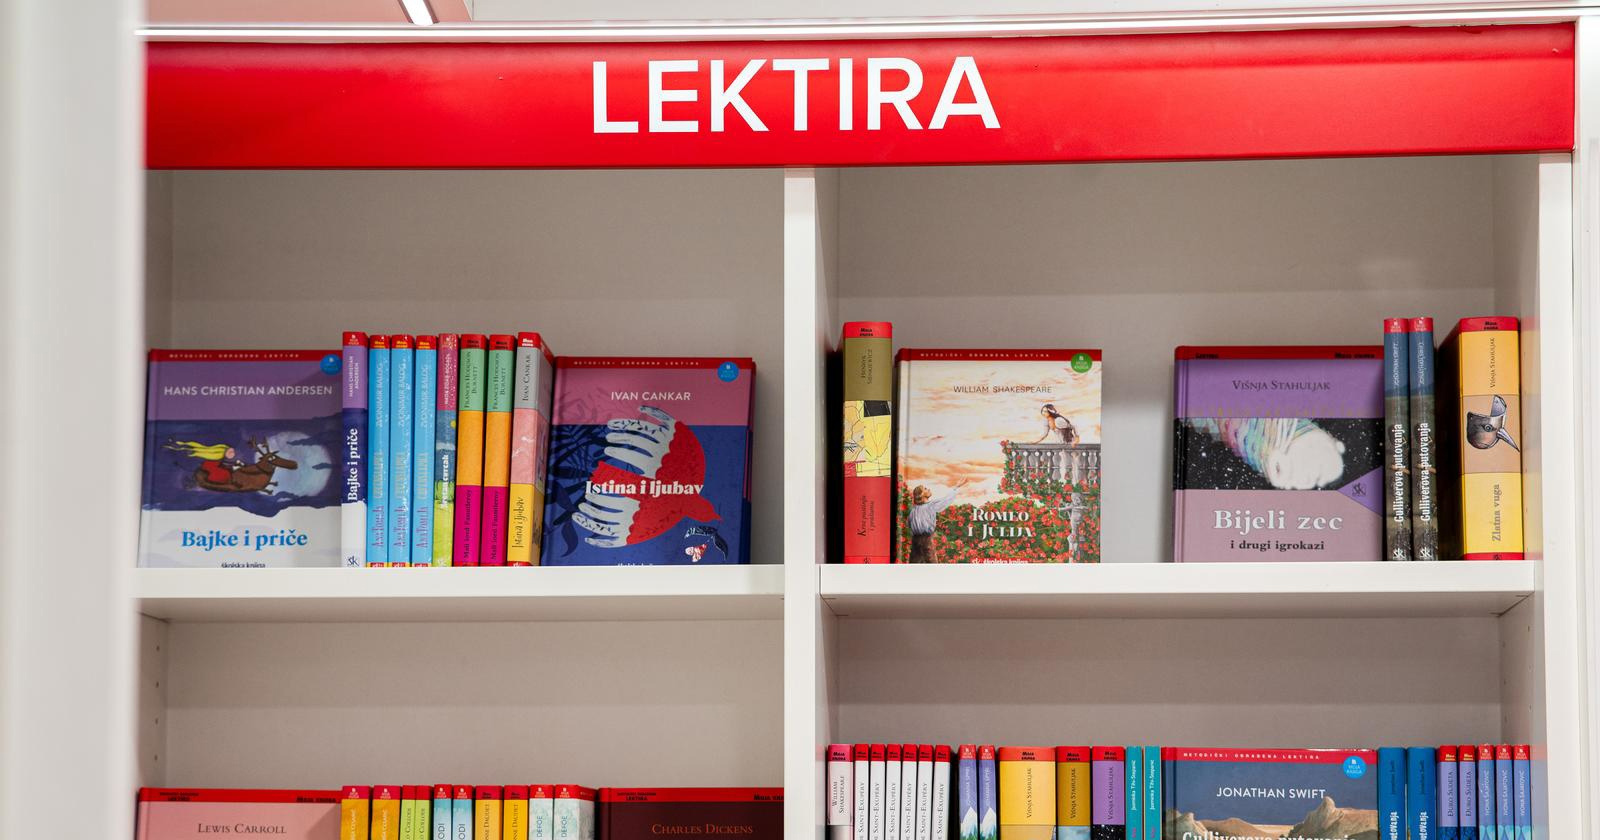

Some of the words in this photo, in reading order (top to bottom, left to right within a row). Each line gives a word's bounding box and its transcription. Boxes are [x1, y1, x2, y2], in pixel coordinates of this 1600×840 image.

[593, 56, 1000, 133] LEKTIRA
[164, 386, 198, 396] HANS
[201, 386, 265, 396] CHRISTIAN
[267, 385, 333, 395] ANDERSEN
[611, 391, 639, 400] IVAN
[642, 391, 691, 401] CANKAR
[953, 385, 989, 393] WILLIAM
[992, 385, 1053, 393] SHAKESPEARE
[1232, 380, 1268, 392] VIŠNJA
[1271, 380, 1331, 392] STAHULJAK
[347, 427, 360, 459] priče
[1392, 424, 1406, 468] putovanja
[1418, 422, 1432, 468] putovanja
[347, 467, 360, 501] Bajke
[585, 480, 637, 495] Istina
[640, 480, 646, 494] i
[649, 480, 704, 498] ljubav
[1419, 469, 1430, 521] Gulliverova
[1393, 471, 1404, 522] Gulliverova
[1493, 484, 1503, 508] vuga
[973, 508, 1029, 521] ROMEO
[1213, 510, 1286, 536] Bijeli
[1297, 516, 1343, 530] zec
[1491, 510, 1501, 542] Zlatna
[182, 530, 239, 551] Bajke
[243, 530, 250, 546] i
[255, 529, 308, 551] priče
[1230, 540, 1234, 549] i
[1239, 540, 1271, 552] drugi
[1275, 540, 1325, 552] igrokazi
[1216, 787, 1285, 798] JONATHAN
[1289, 788, 1325, 799] SWIFT
[198, 823, 231, 833] LEWIS
[234, 823, 287, 834] CARROLL
[652, 823, 702, 834] CHARLES
[705, 823, 753, 834] DICKENS
